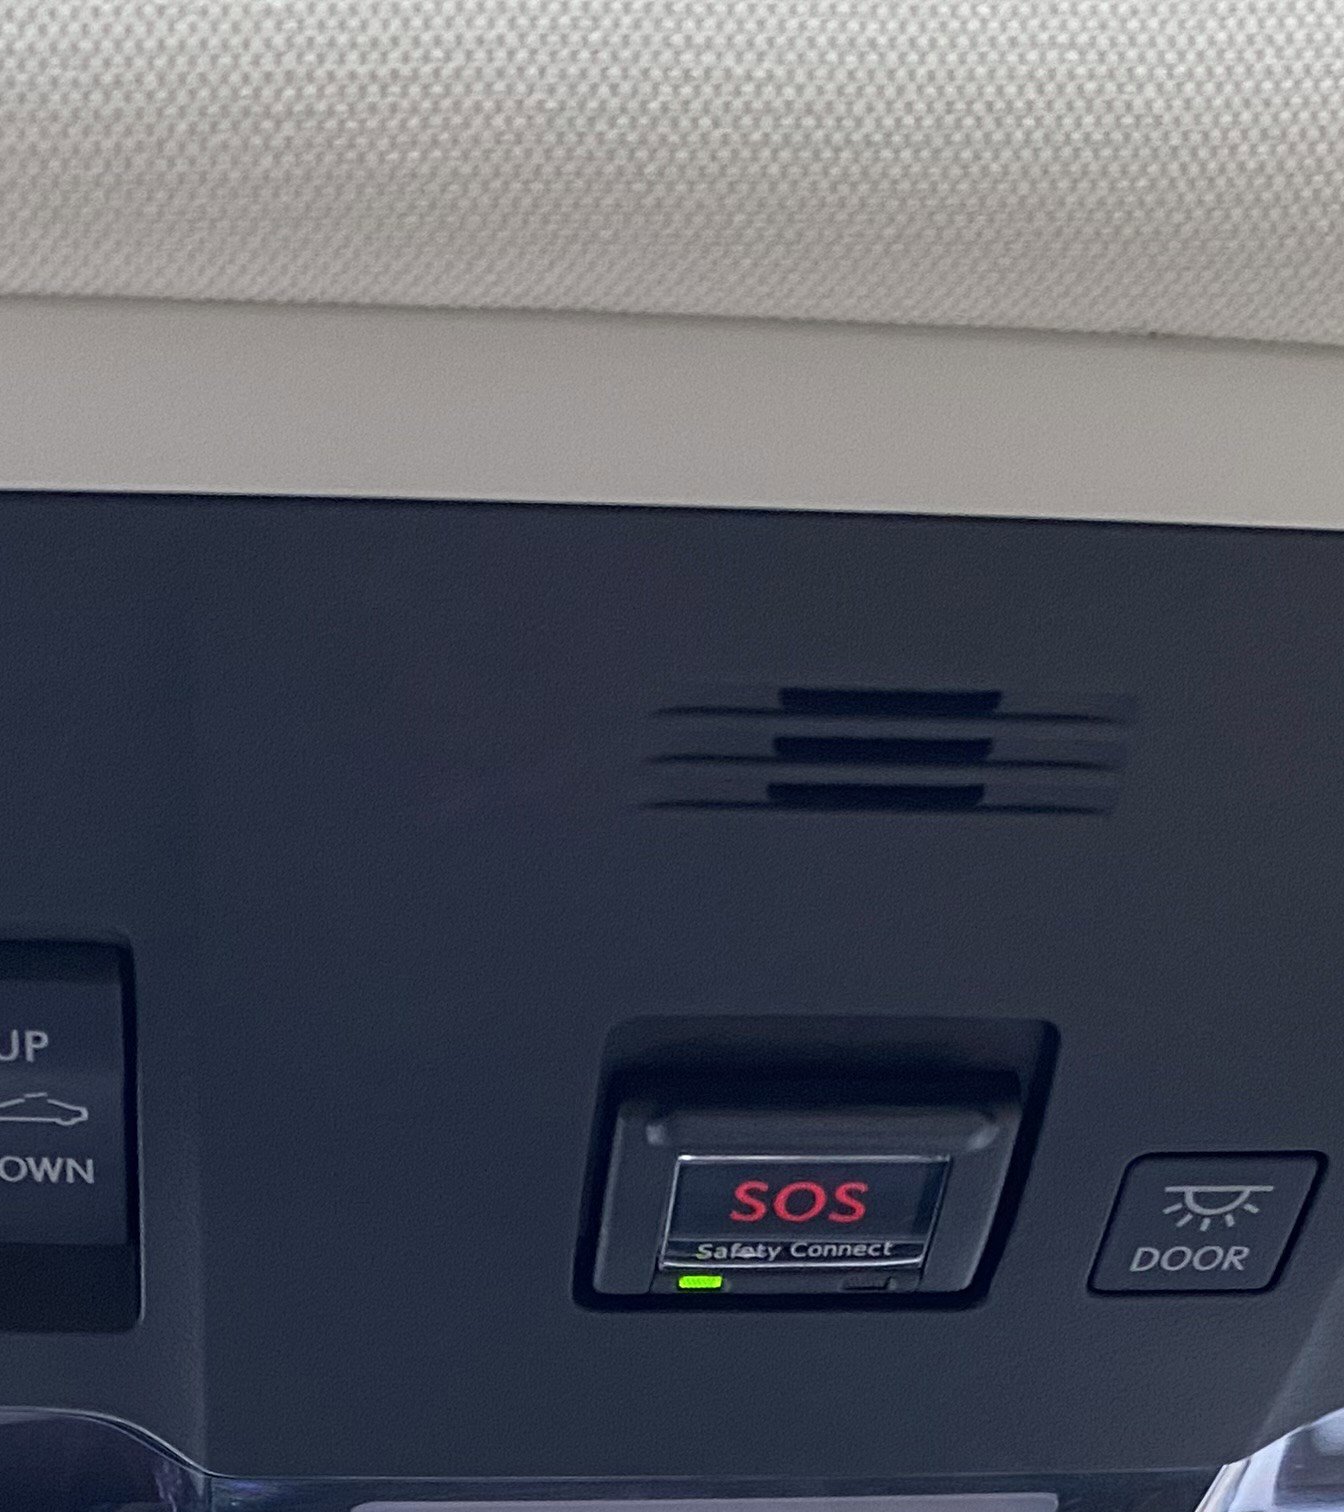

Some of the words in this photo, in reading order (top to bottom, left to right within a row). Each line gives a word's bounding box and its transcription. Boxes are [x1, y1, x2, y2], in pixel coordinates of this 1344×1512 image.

[729, 1180, 869, 1223] SOS
[695, 1242, 782, 1261] Safety
[790, 1240, 894, 1259] Connect
[1129, 1245, 1251, 1272] DOOR
